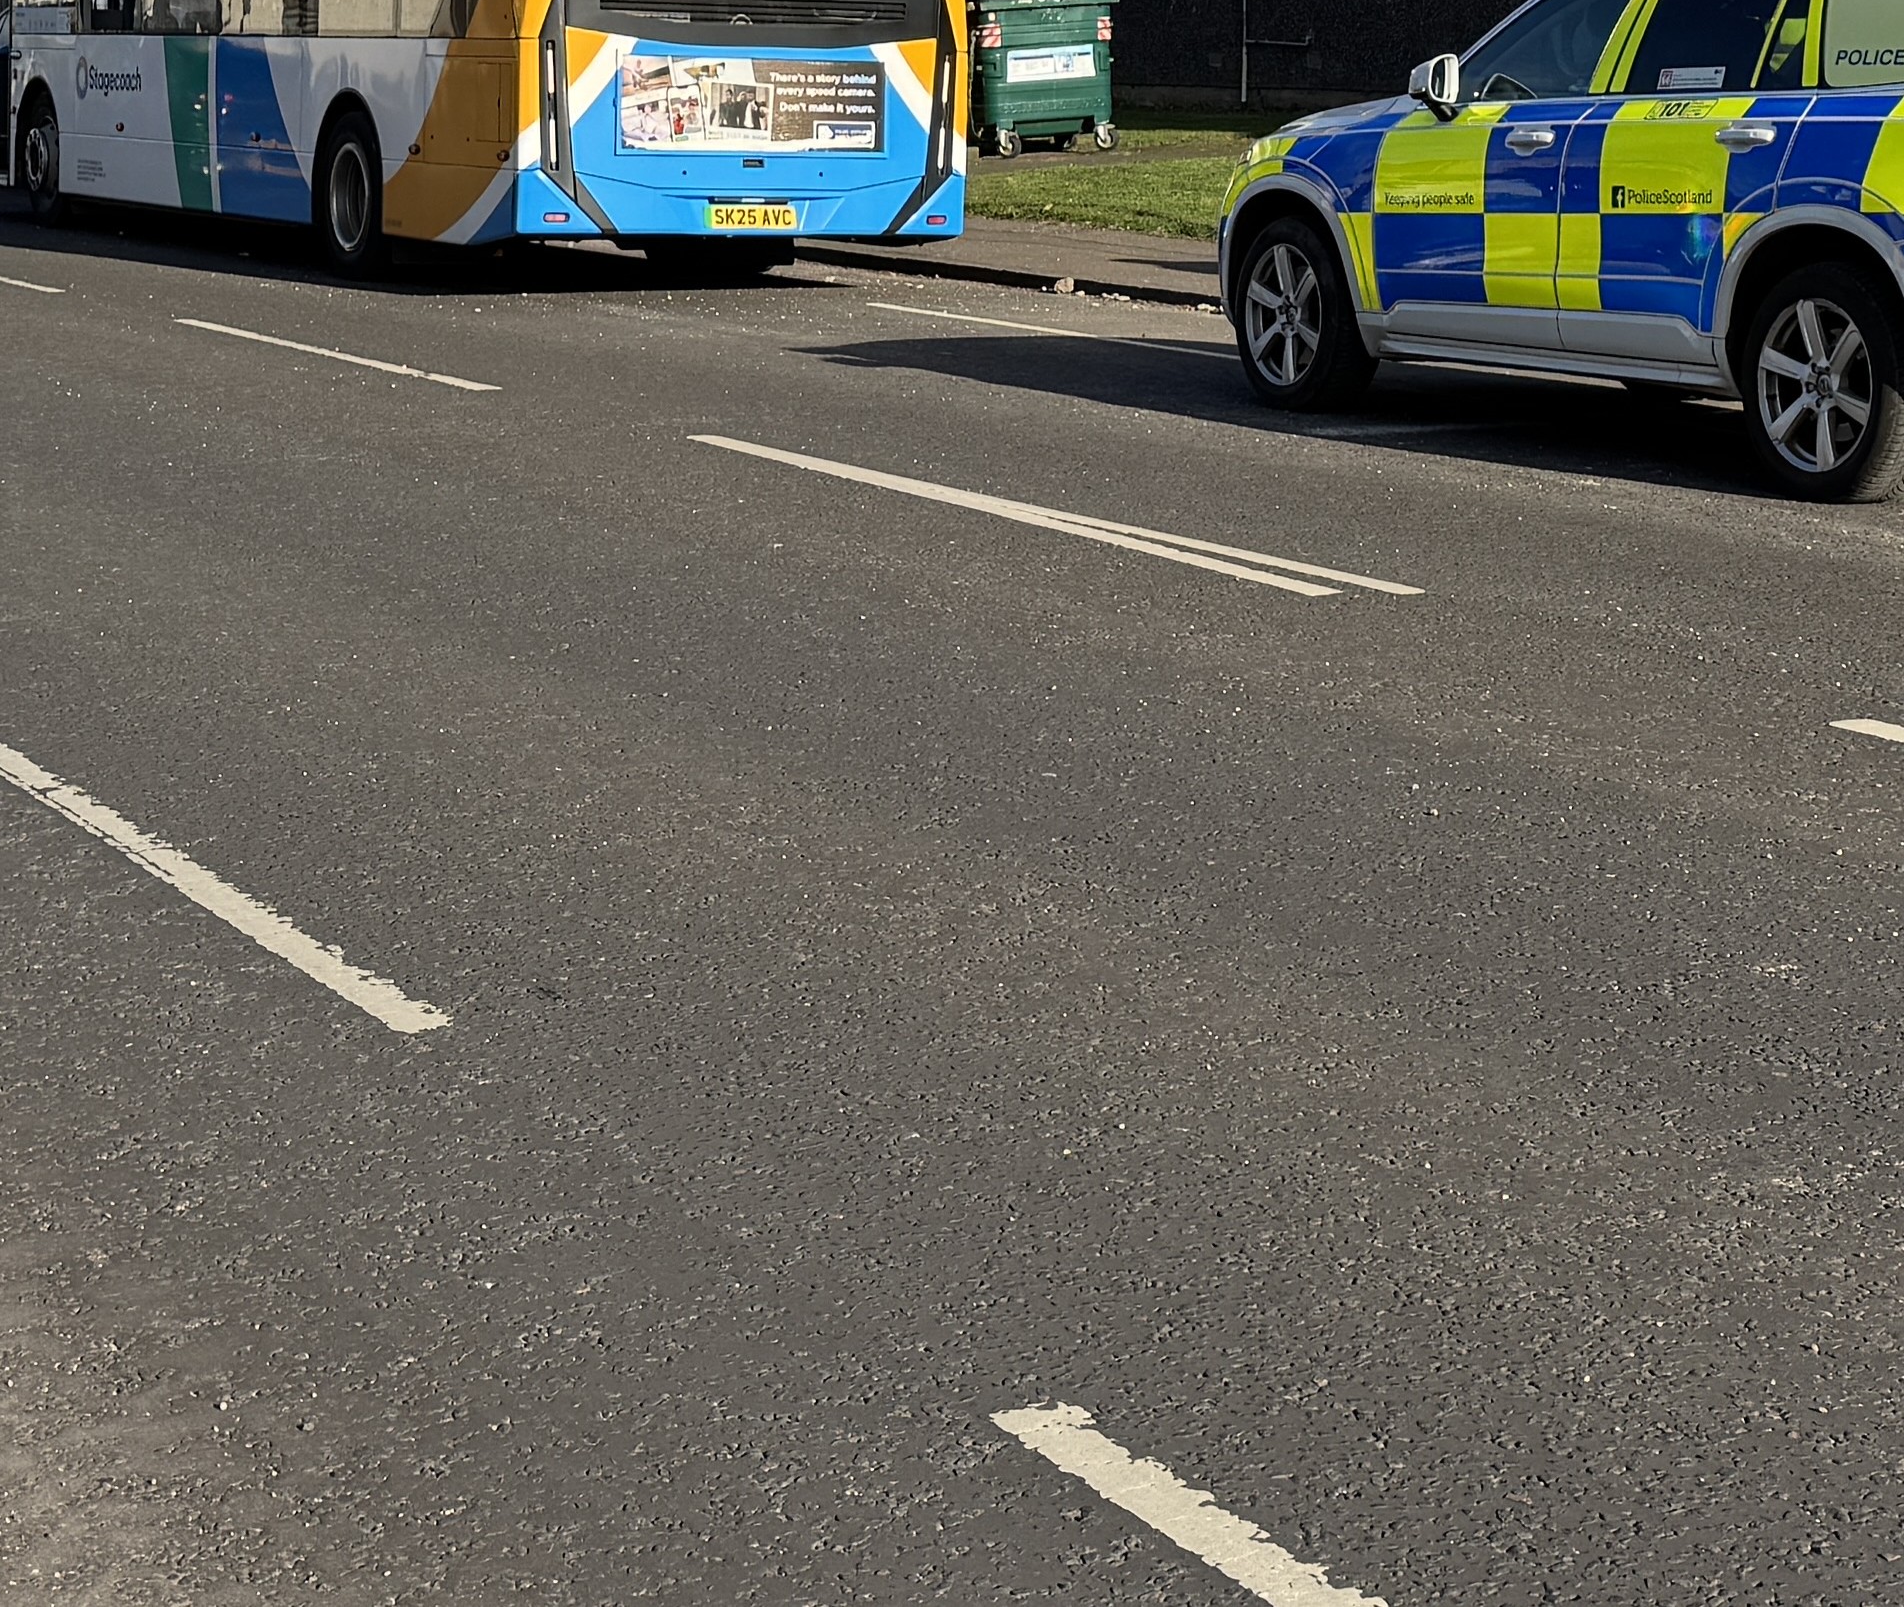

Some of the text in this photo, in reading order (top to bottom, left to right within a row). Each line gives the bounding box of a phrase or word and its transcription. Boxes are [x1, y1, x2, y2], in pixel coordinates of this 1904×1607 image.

[89, 64, 142, 97] Stagecoach
[769, 72, 806, 83] There's
[816, 74, 841, 85] story
[842, 74, 877, 84] behind
[776, 87, 804, 97] every
[806, 86, 836, 97] speed
[779, 101, 807, 113] Don't
[808, 102, 835, 113] make
[836, 103, 844, 113] it
[1659, 102, 1691, 118] 101
[1422, 192, 1453, 208] people
[1454, 192, 1475, 205] safe
[1627, 188, 1712, 205] PoliceScotland
[714, 208, 792, 226] SK25 AVC
